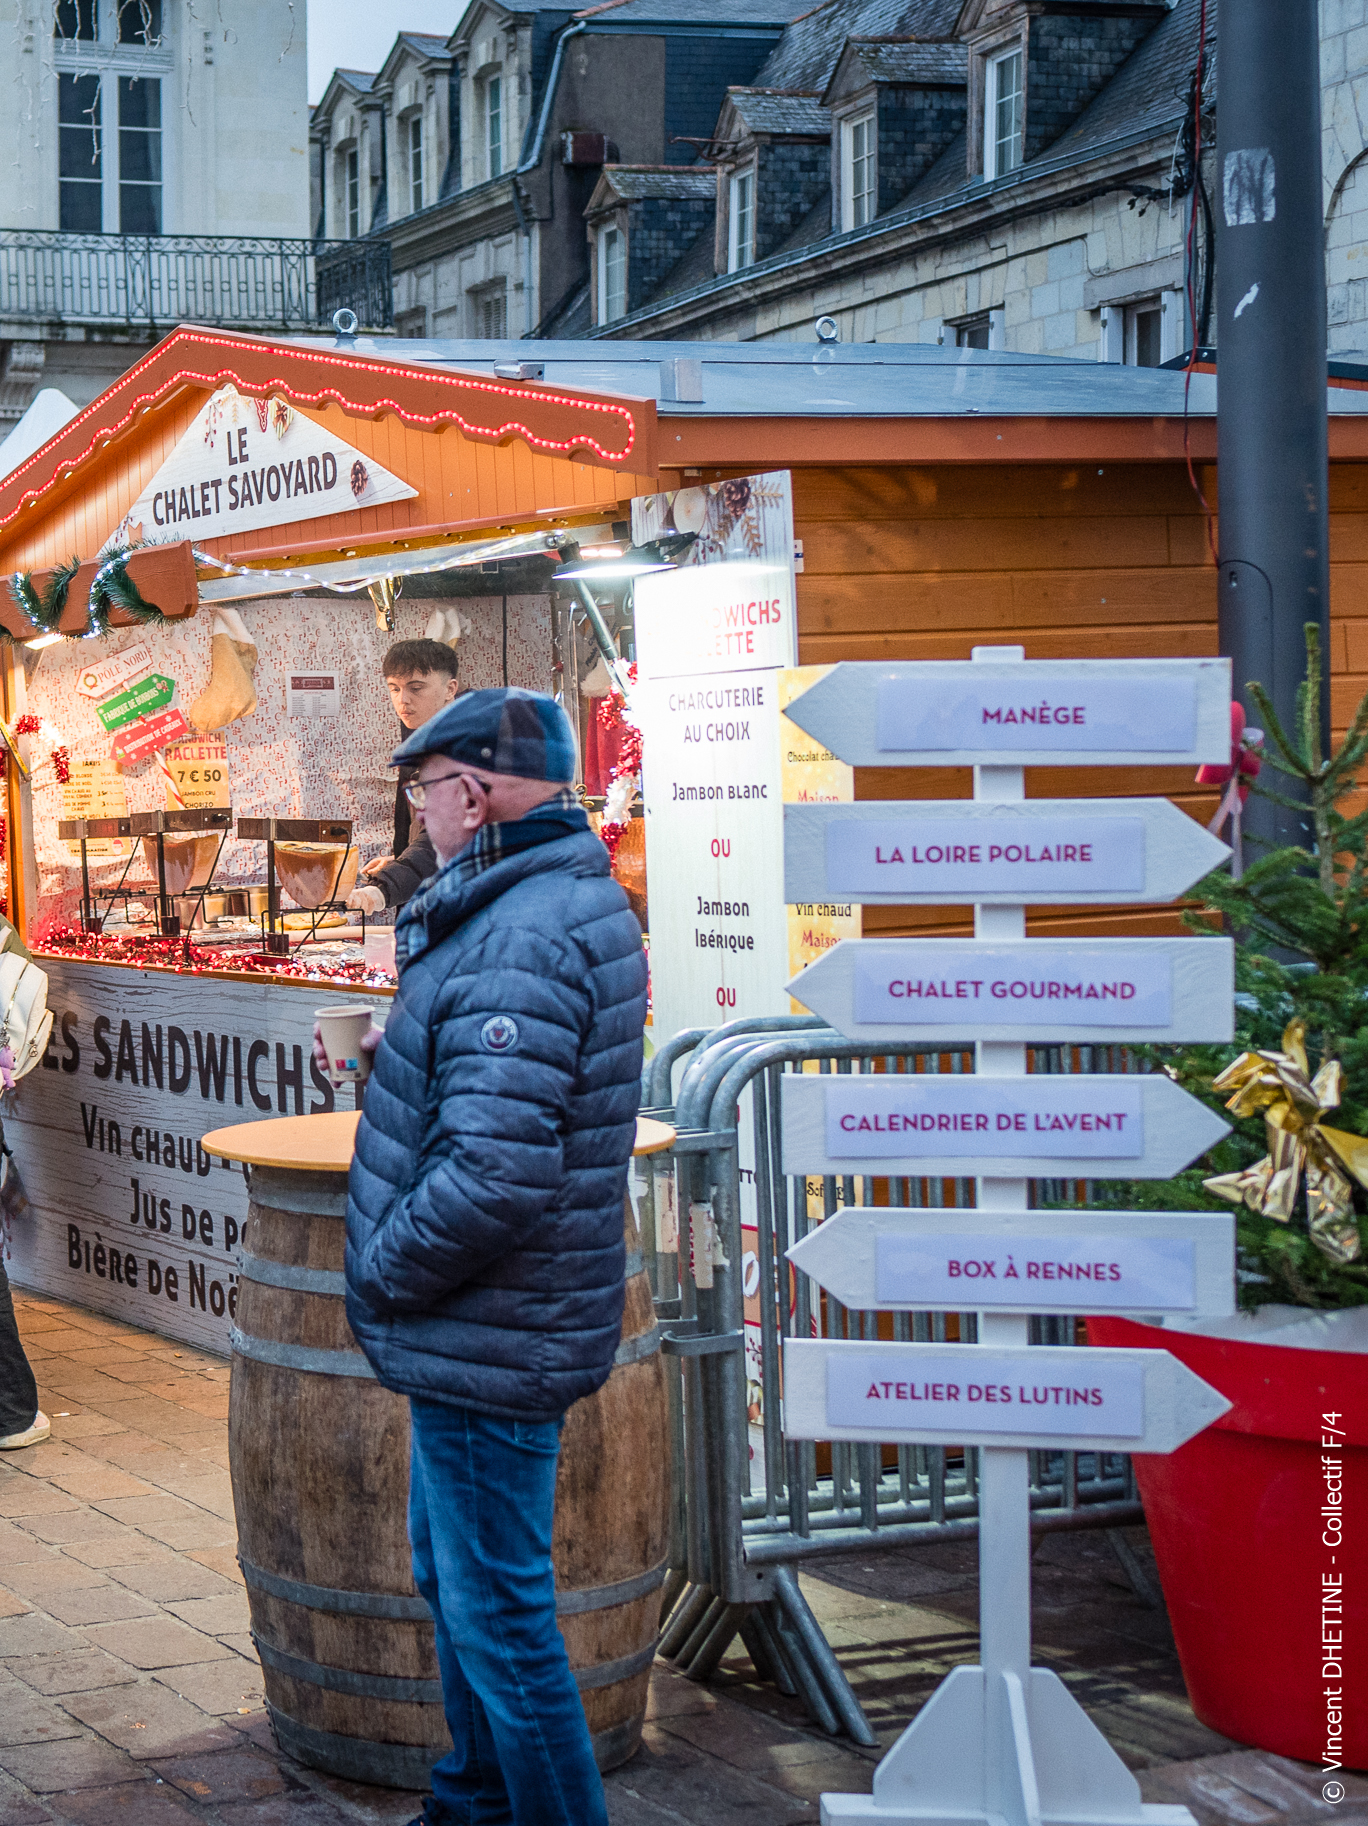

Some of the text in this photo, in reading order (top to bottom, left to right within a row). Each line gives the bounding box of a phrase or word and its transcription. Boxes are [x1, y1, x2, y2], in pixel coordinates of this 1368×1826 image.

[226, 426, 249, 466] LE
[152, 451, 337, 526] CHALET SAVOYARD
[123, 650, 148, 668] NORD
[669, 686, 764, 712] CHARCUTERIE
[102, 702, 130, 723] FABRIQUE
[127, 698, 138, 710] DE
[983, 701, 1085, 724] MANÈGE
[153, 728, 162, 739] DE
[684, 721, 750, 746] AU CHOIX
[165, 746, 228, 761] RACLETTE
[787, 750, 819, 763] Chocolat
[177, 769, 222, 783] 7 € 50
[184, 801, 214, 809] CHORIZO
[710, 838, 731, 858] OU
[876, 844, 1091, 863] LA LOIRE POLAIRE
[795, 903, 852, 917] Vin chaud
[801, 929, 841, 948] Maiso
[716, 987, 737, 1007] OU
[889, 980, 1135, 999] CHALET GOURMAND
[93, 1014, 335, 1116] SANDWICHS
[840, 1114, 988, 1131] CALENDRIER
[997, 1113, 1026, 1131] DE
[948, 1255, 1121, 1281] BOX À RENNES
[189, 1259, 239, 1319] Noë
[866, 1382, 1103, 1406] ATELIER DES LUTINS
